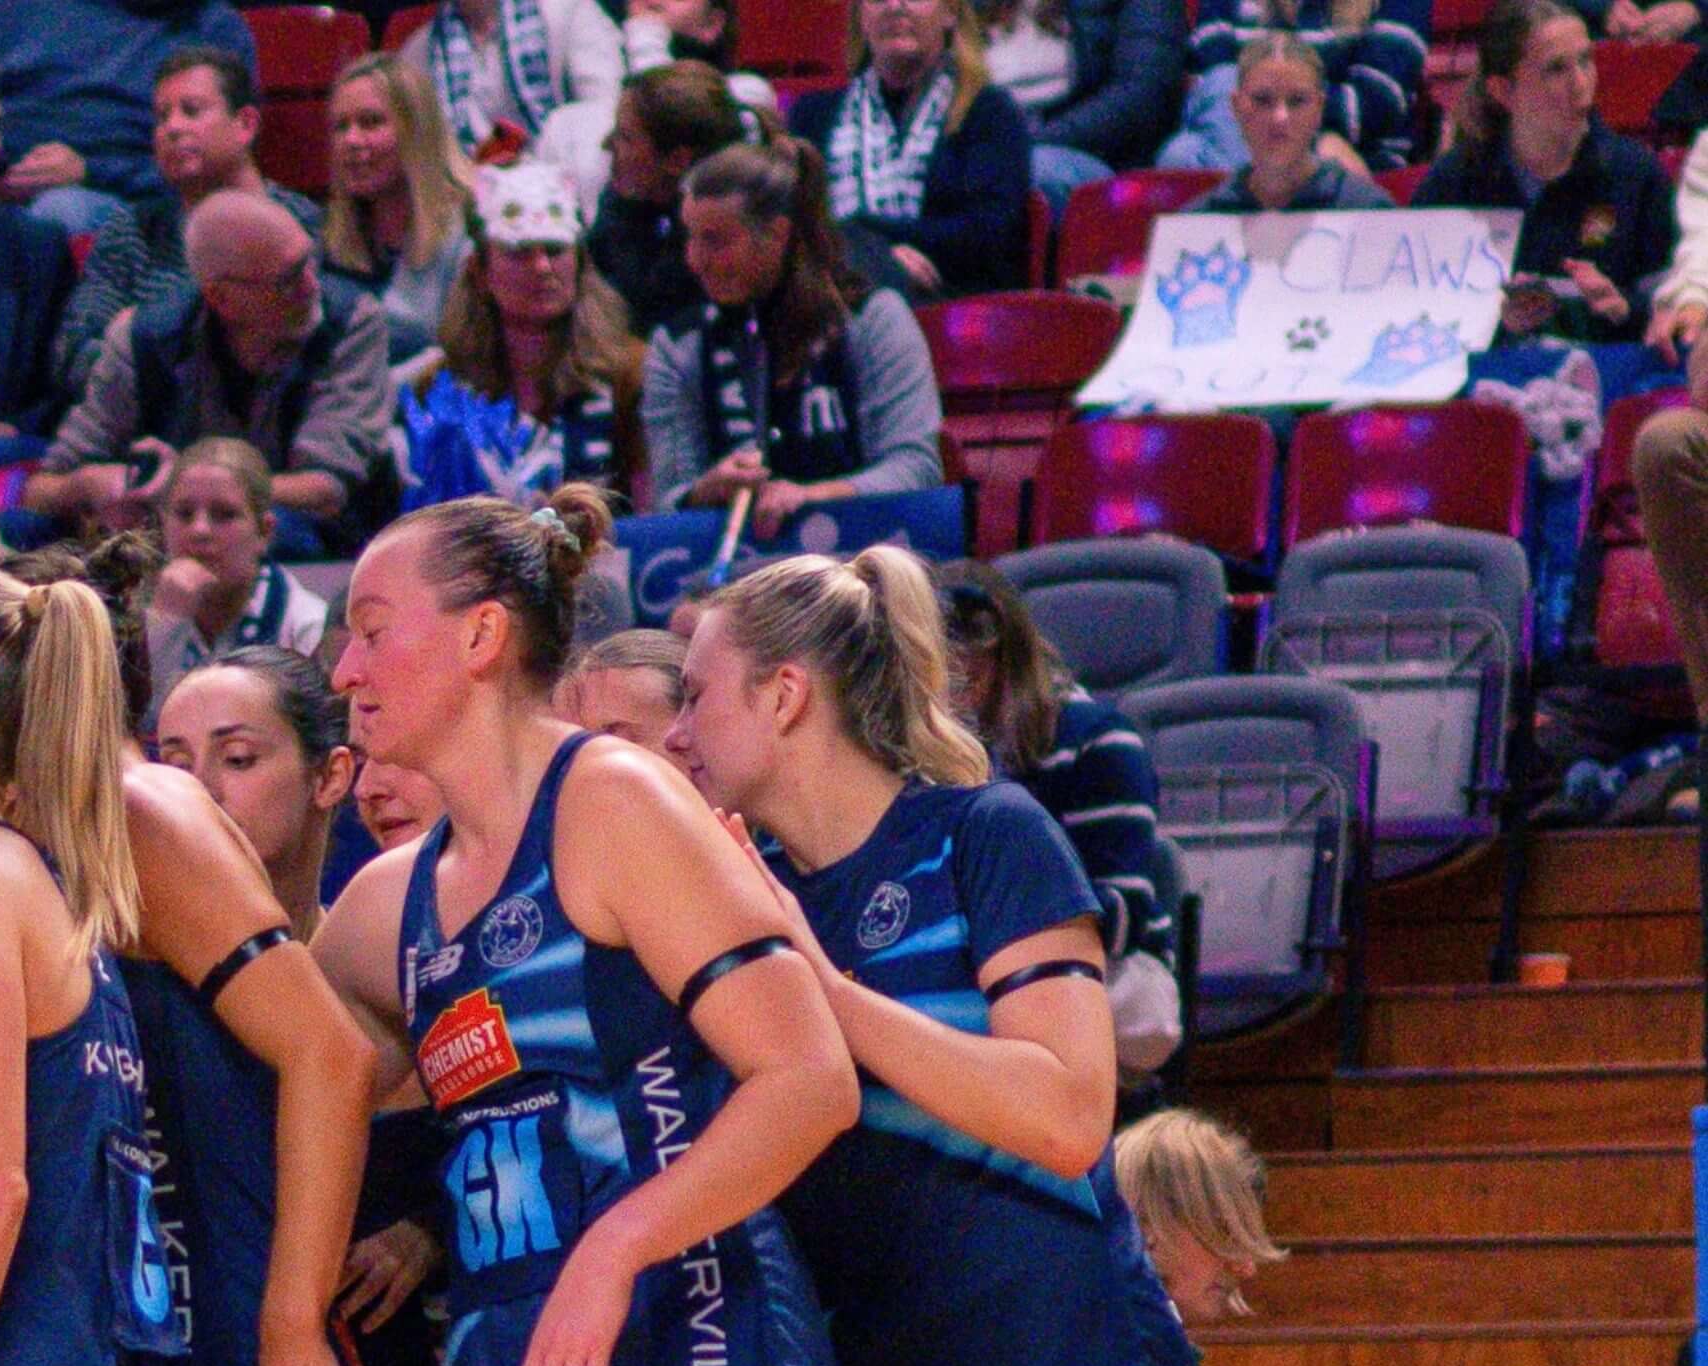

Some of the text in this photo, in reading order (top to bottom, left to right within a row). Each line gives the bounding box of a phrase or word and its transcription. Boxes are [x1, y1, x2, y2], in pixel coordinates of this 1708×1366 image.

[1279, 228, 1508, 294] CLAWS
[423, 1018, 499, 1083] CHEMIST
[445, 1115, 564, 1272] GK
